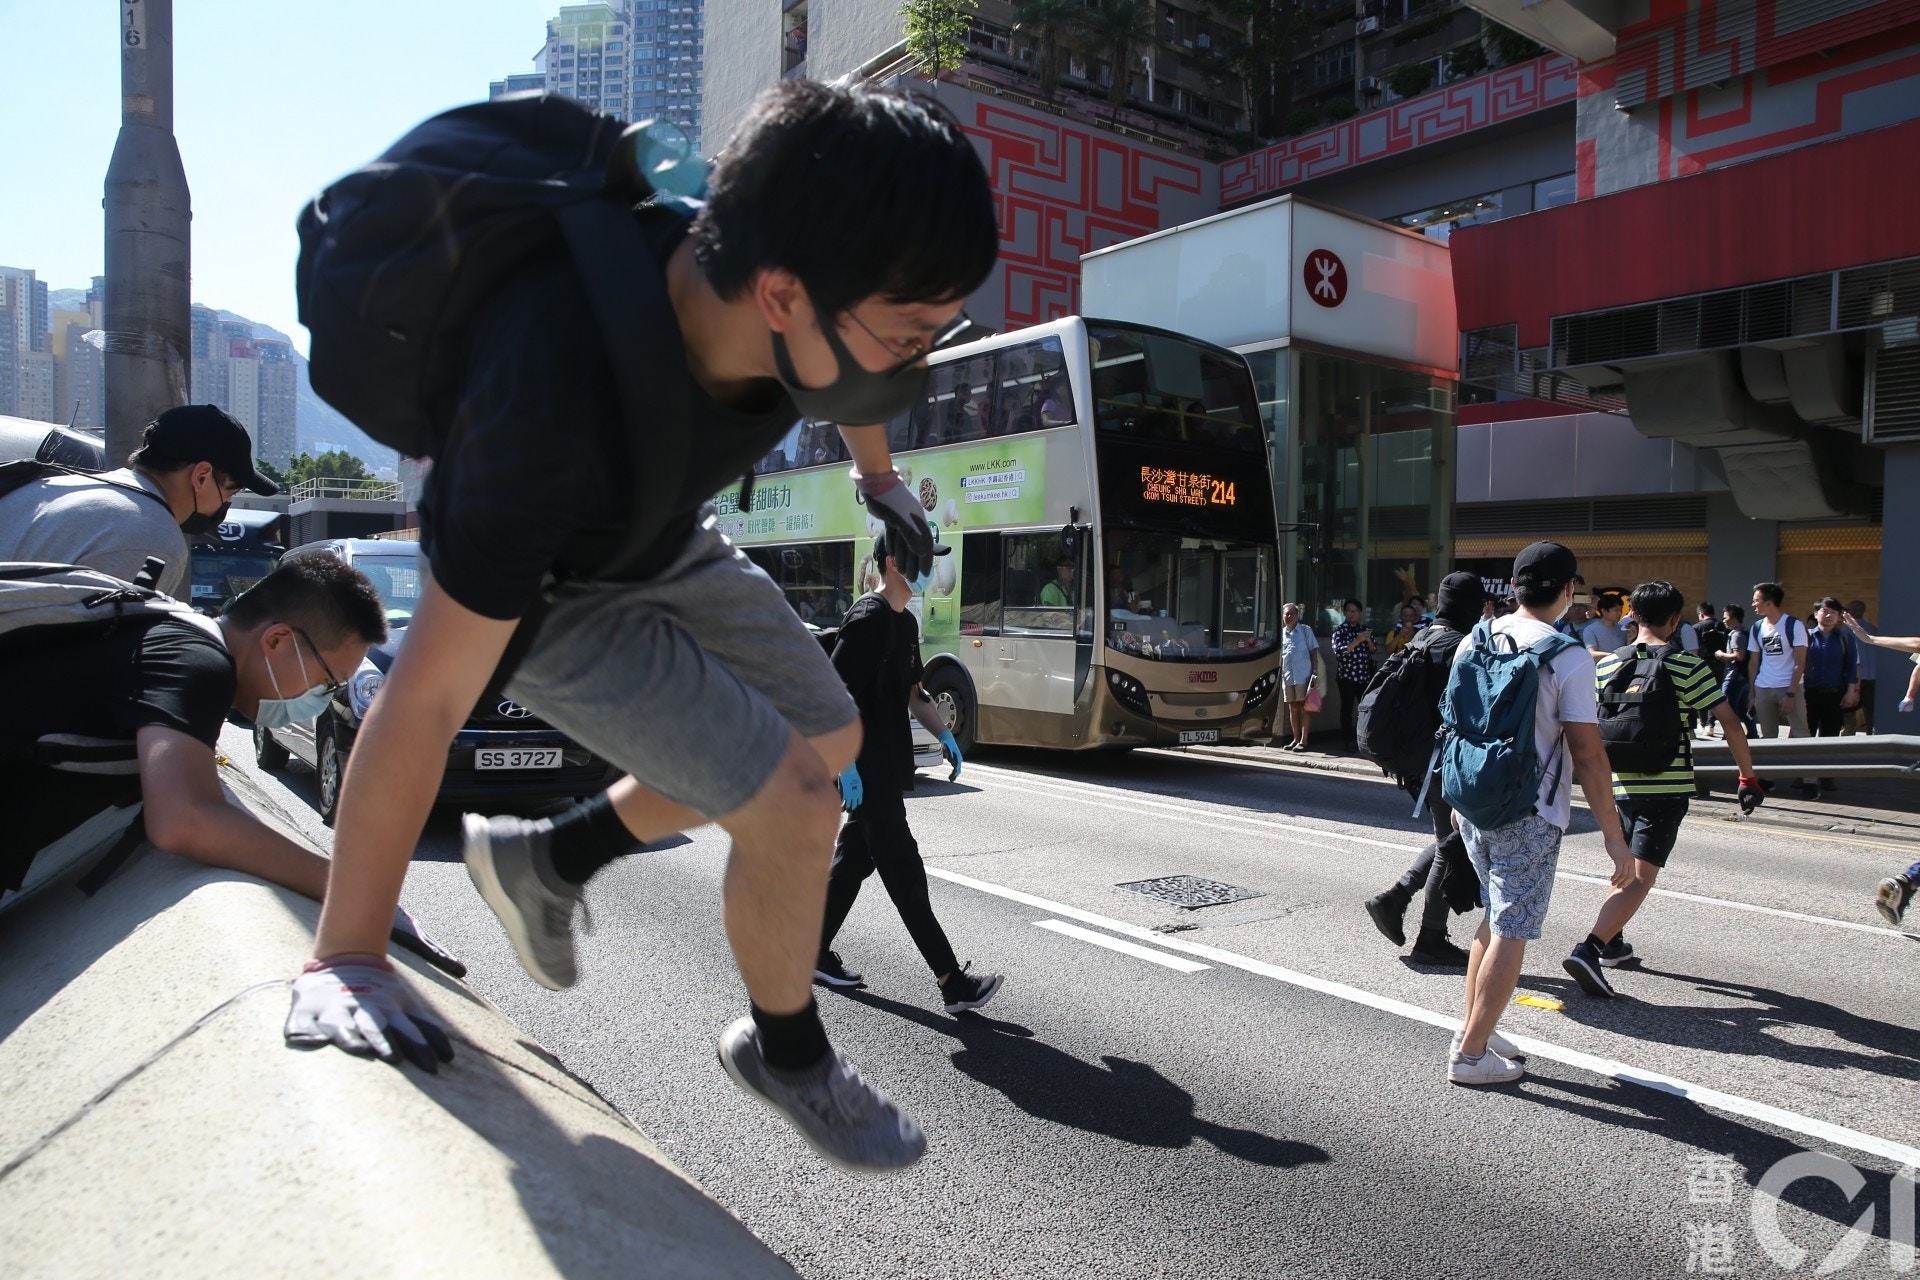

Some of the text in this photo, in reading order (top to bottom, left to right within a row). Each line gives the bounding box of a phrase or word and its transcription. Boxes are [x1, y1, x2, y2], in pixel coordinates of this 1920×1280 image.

[124, 0, 141, 46] 16
[970, 459, 1017, 472] www.LKK.com
[1147, 482, 1204, 498] CHEUNG SHA WAN
[1161, 492, 1178, 503] TSUN
[1211, 480, 1236, 506] 214
[1182, 730, 1216, 742] TL 5943
[481, 751, 557, 767] SS 3727
